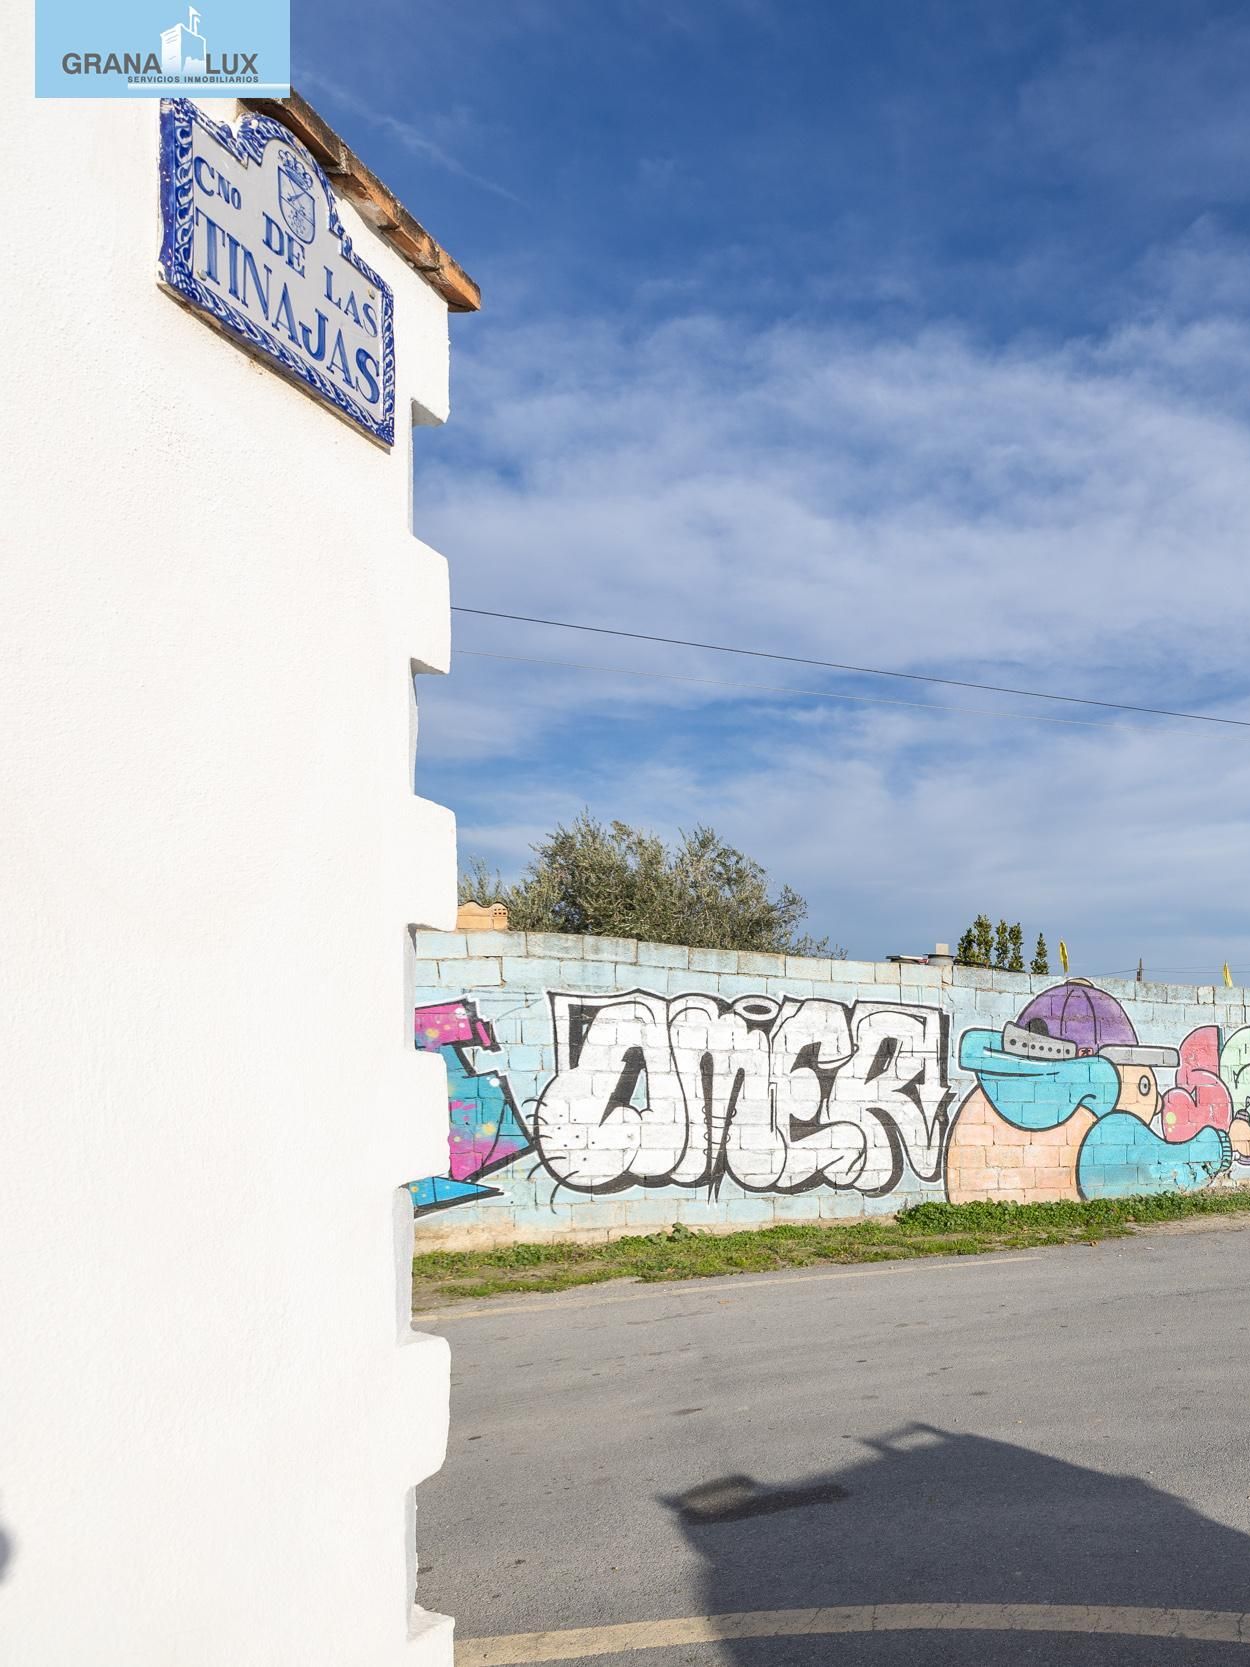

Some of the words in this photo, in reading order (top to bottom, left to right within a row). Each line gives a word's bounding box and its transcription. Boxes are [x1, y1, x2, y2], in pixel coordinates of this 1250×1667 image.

[195, 206, 381, 405] TINAJAS
[262, 211, 306, 279] DE
[323, 265, 378, 338] LAS
